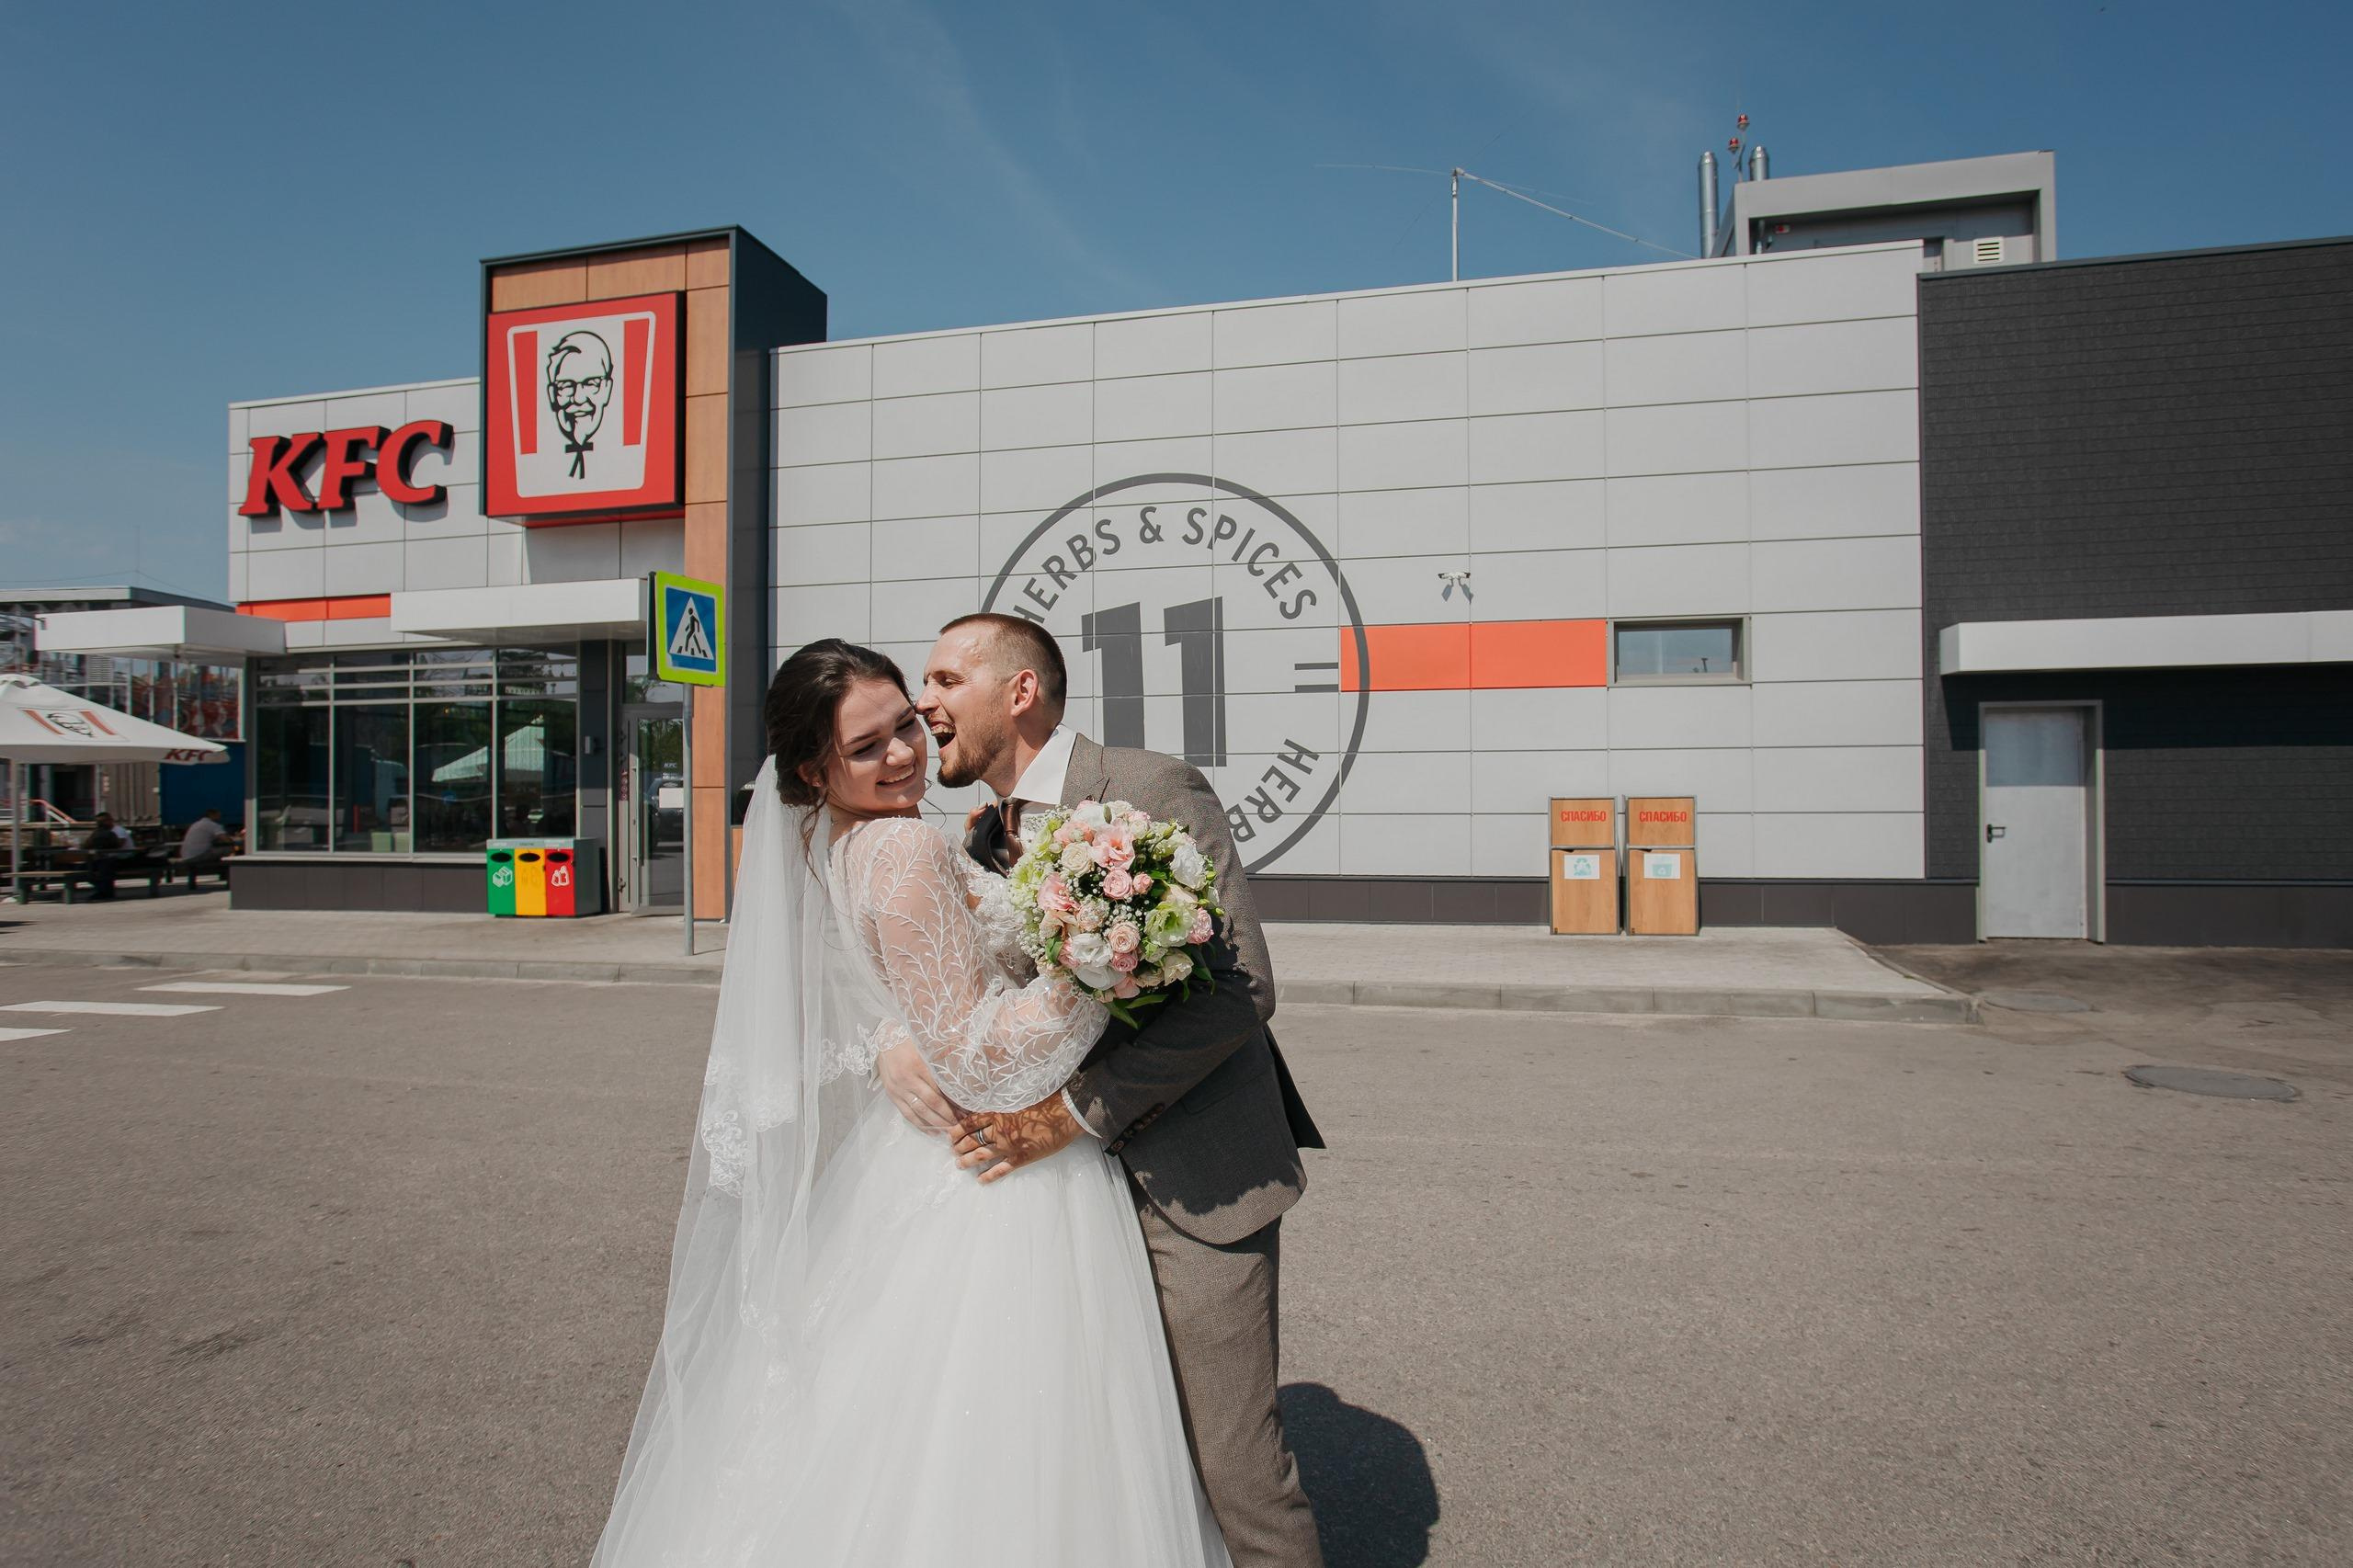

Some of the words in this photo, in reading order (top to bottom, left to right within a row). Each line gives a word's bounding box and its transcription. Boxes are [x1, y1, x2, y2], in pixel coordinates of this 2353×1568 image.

[238, 420, 453, 517] KFC
[1139, 506, 1165, 544] &
[1182, 507, 1317, 619] SPICES
[1082, 596, 1227, 767] 11
[1225, 738, 1320, 843] HERB
[1561, 811, 1607, 822] СПАСИБО
[1639, 811, 1687, 823] СПАСИБО
